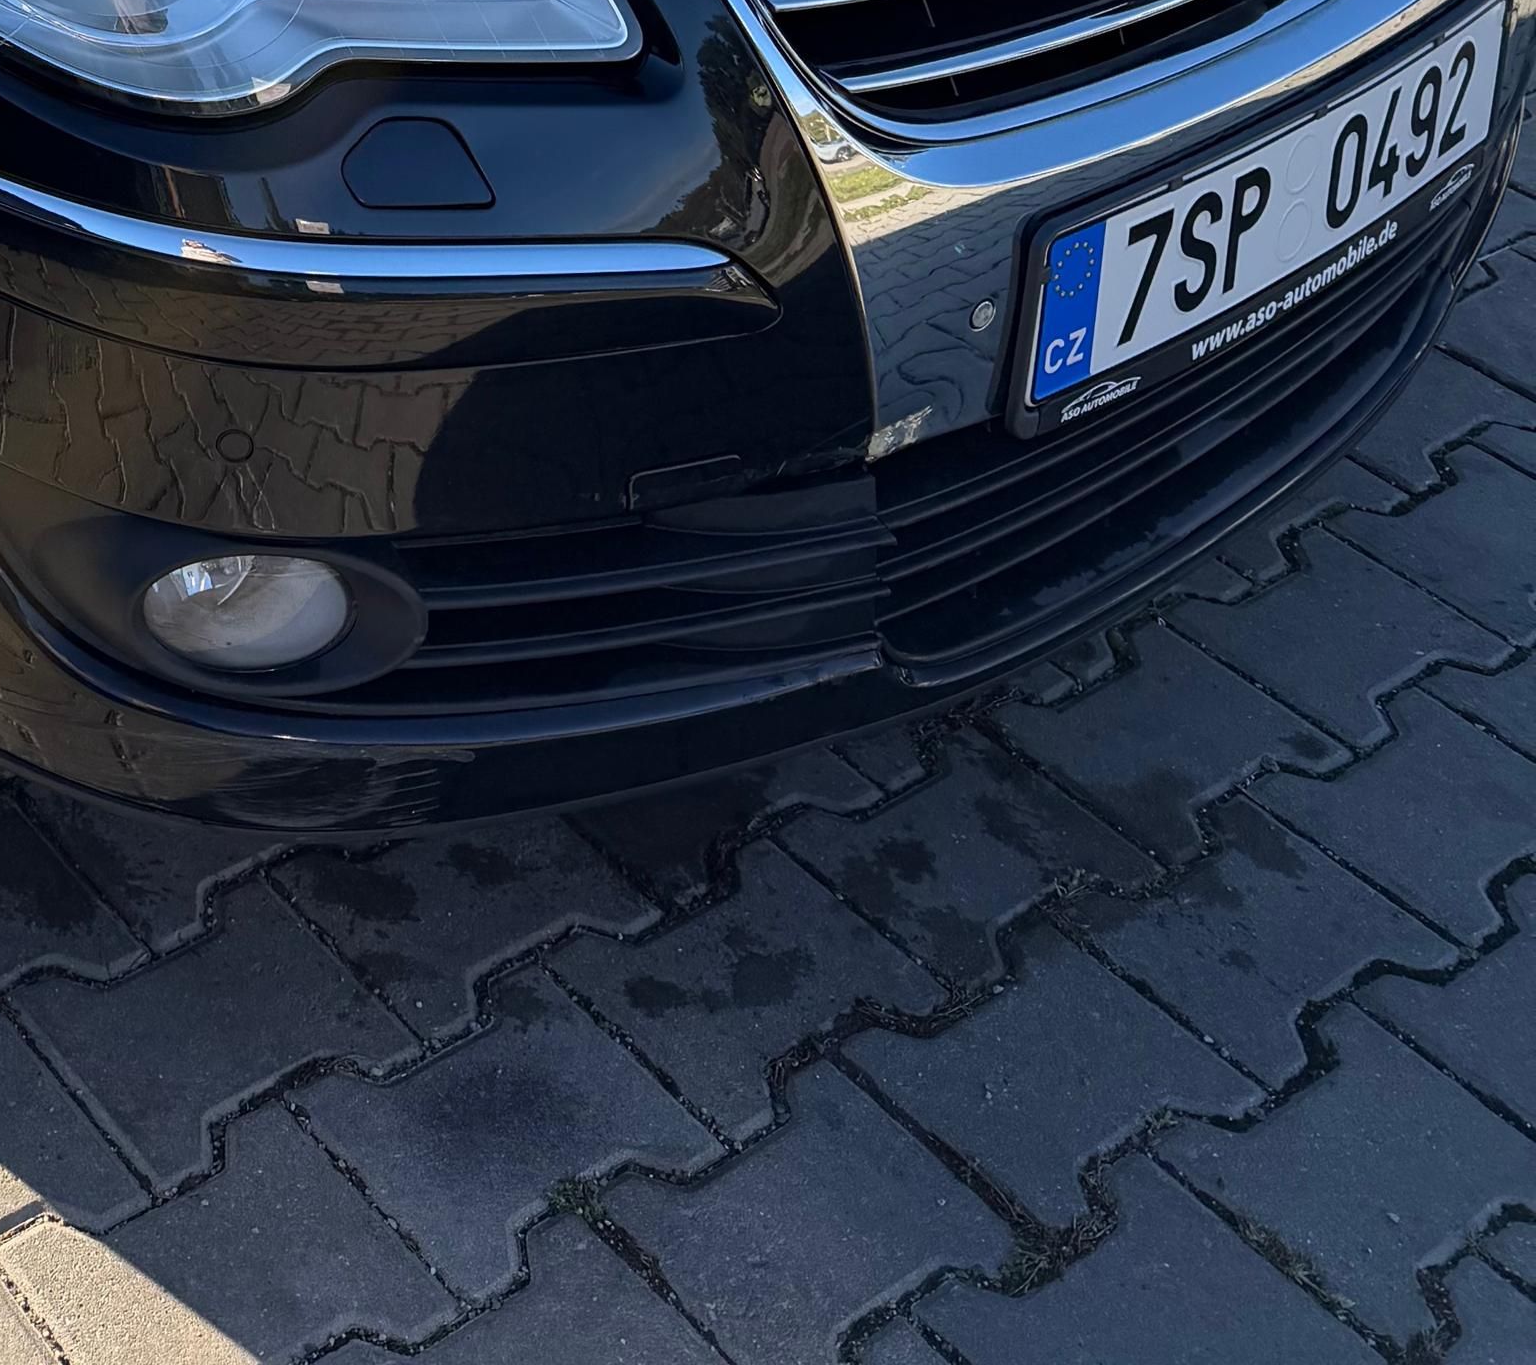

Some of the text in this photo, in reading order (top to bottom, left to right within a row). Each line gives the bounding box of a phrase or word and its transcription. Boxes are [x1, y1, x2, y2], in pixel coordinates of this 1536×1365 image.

[1118, 40, 1476, 347] 7SP 0492
[1191, 220, 1398, 361] www.aso-automobile.de
[1044, 327, 1087, 374] CZ
[1061, 380, 1139, 423] ASO AUTOMOBILE
